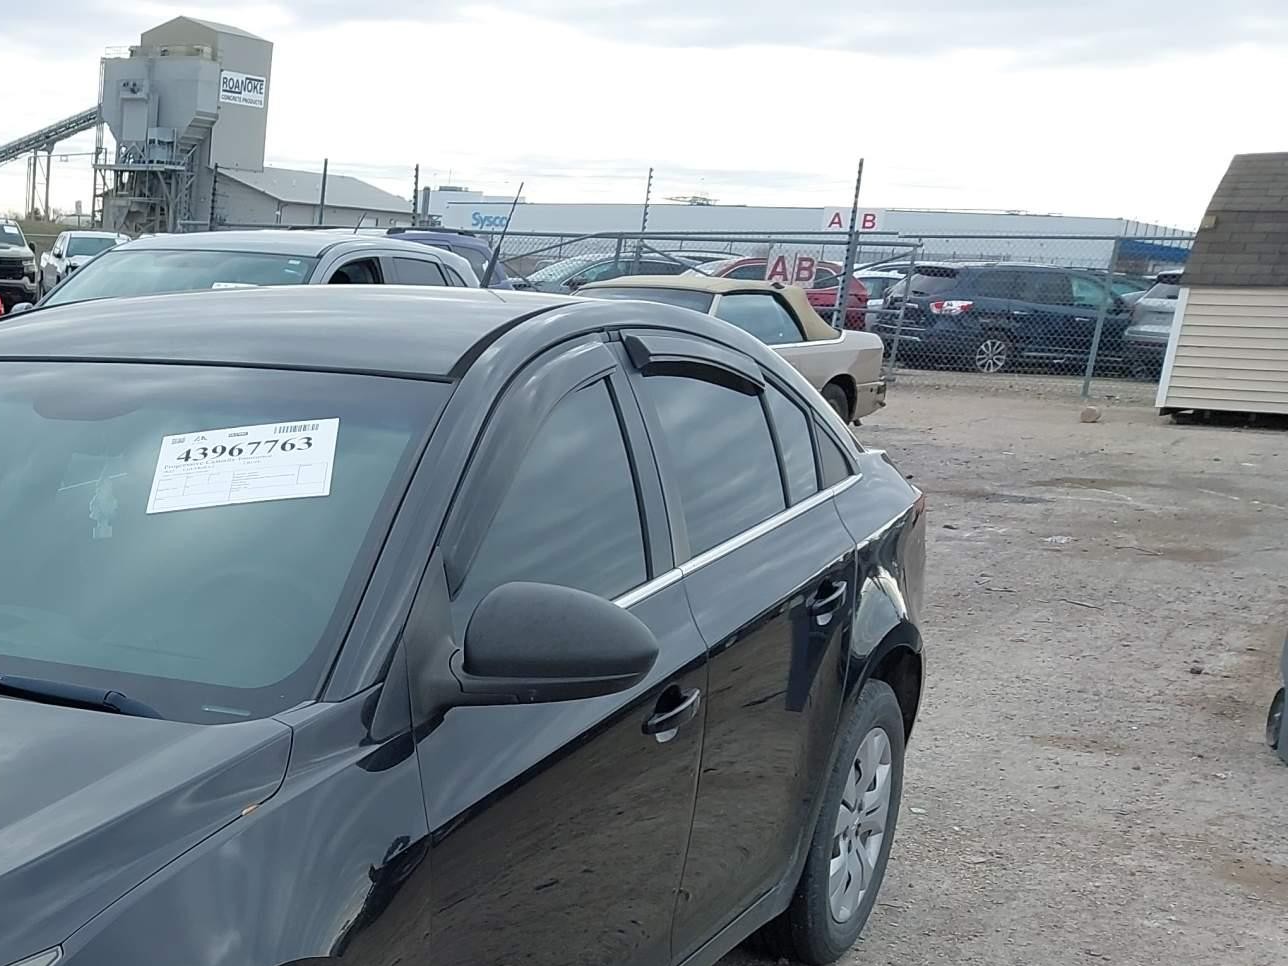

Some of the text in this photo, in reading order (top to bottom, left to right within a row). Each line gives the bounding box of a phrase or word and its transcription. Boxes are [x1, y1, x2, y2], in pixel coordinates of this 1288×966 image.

[223, 77, 264, 95] ROANOKE
[471, 211, 508, 229] Sysco
[828, 212, 877, 229] A B
[767, 255, 816, 282] A B
[177, 436, 313, 463] 43967763
